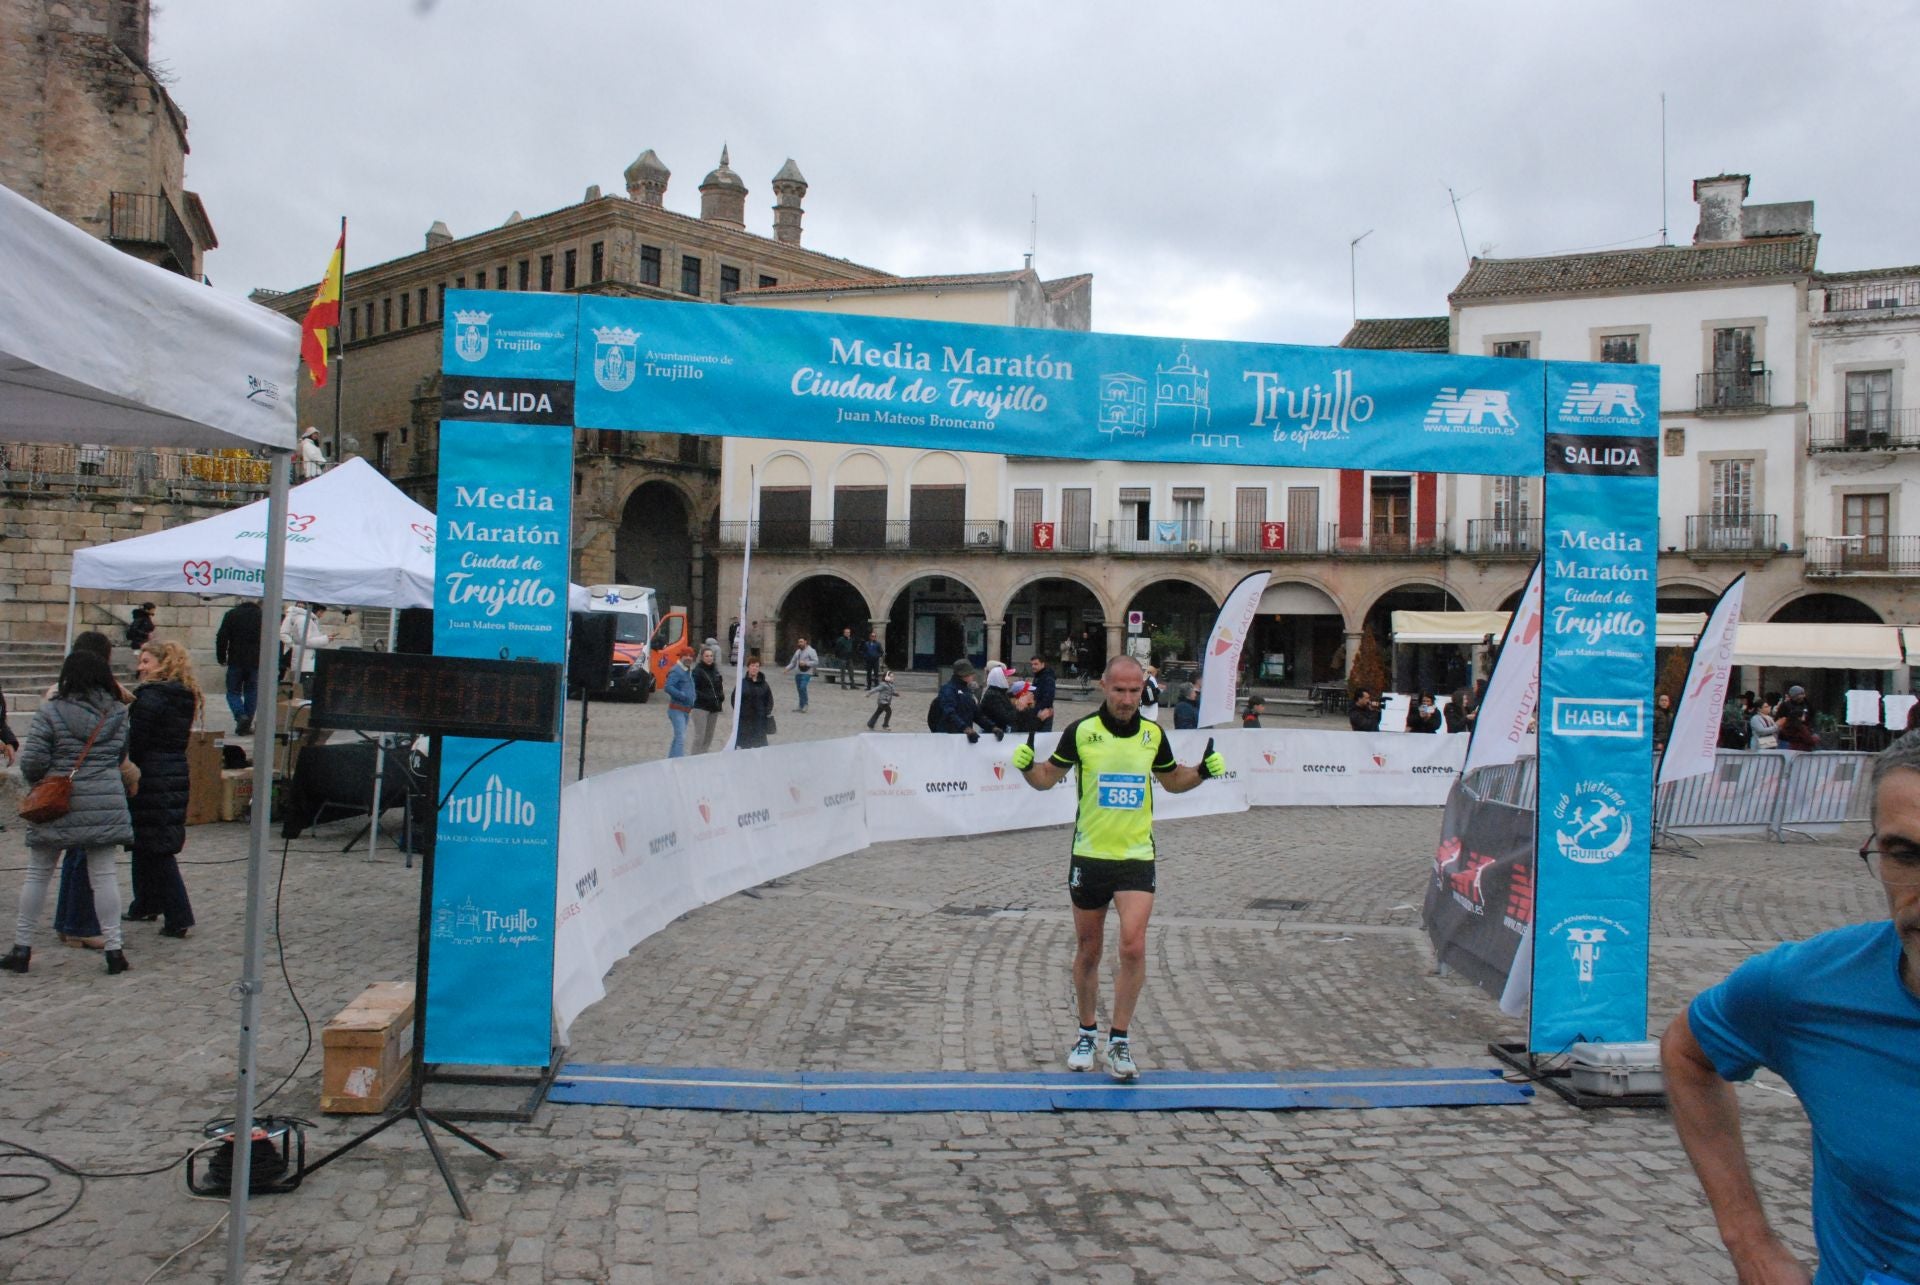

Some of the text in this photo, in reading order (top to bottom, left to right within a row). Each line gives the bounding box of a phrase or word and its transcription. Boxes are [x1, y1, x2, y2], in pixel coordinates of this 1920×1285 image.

[496, 339, 541, 352] Trujillo
[646, 350, 733, 365] Ayuntamiento de
[829, 337, 1074, 381] Media Maratón
[644, 363, 703, 381] Trujillo
[463, 389, 553, 413] SALIDA
[791, 367, 1048, 420] Ciudad de Trujillo
[1243, 369, 1374, 433] Trujillo
[837, 407, 995, 431] Juan Mateos Broncano
[1423, 422, 1515, 436] www.musicrun.es
[1558, 414, 1640, 425] www.musicrun.es
[1273, 422, 1288, 442] te
[1565, 446, 1641, 466] SALIDA
[455, 486, 555, 512] Media
[447, 520, 560, 545] Maratón
[1560, 530, 1642, 552] Media
[461, 551, 544, 571] Ciudad de
[1555, 560, 1648, 581] Maratón
[446, 572, 555, 616] Trujillo
[1565, 588, 1634, 604] Ciudad de
[449, 619, 553, 632] Juan Mateos Broncano
[1552, 606, 1646, 645] Trujillo
[1565, 709, 1630, 727] HABLA
[448, 778, 535, 832] trujillo
[1108, 788, 1138, 805] 585
[1553, 779, 1626, 820] Club Atletismo
[1561, 844, 1615, 860] TRUJILLO
[482, 909, 538, 933] Trujillo
[1573, 946, 1600, 960] A J
[1583, 961, 1589, 974] S
